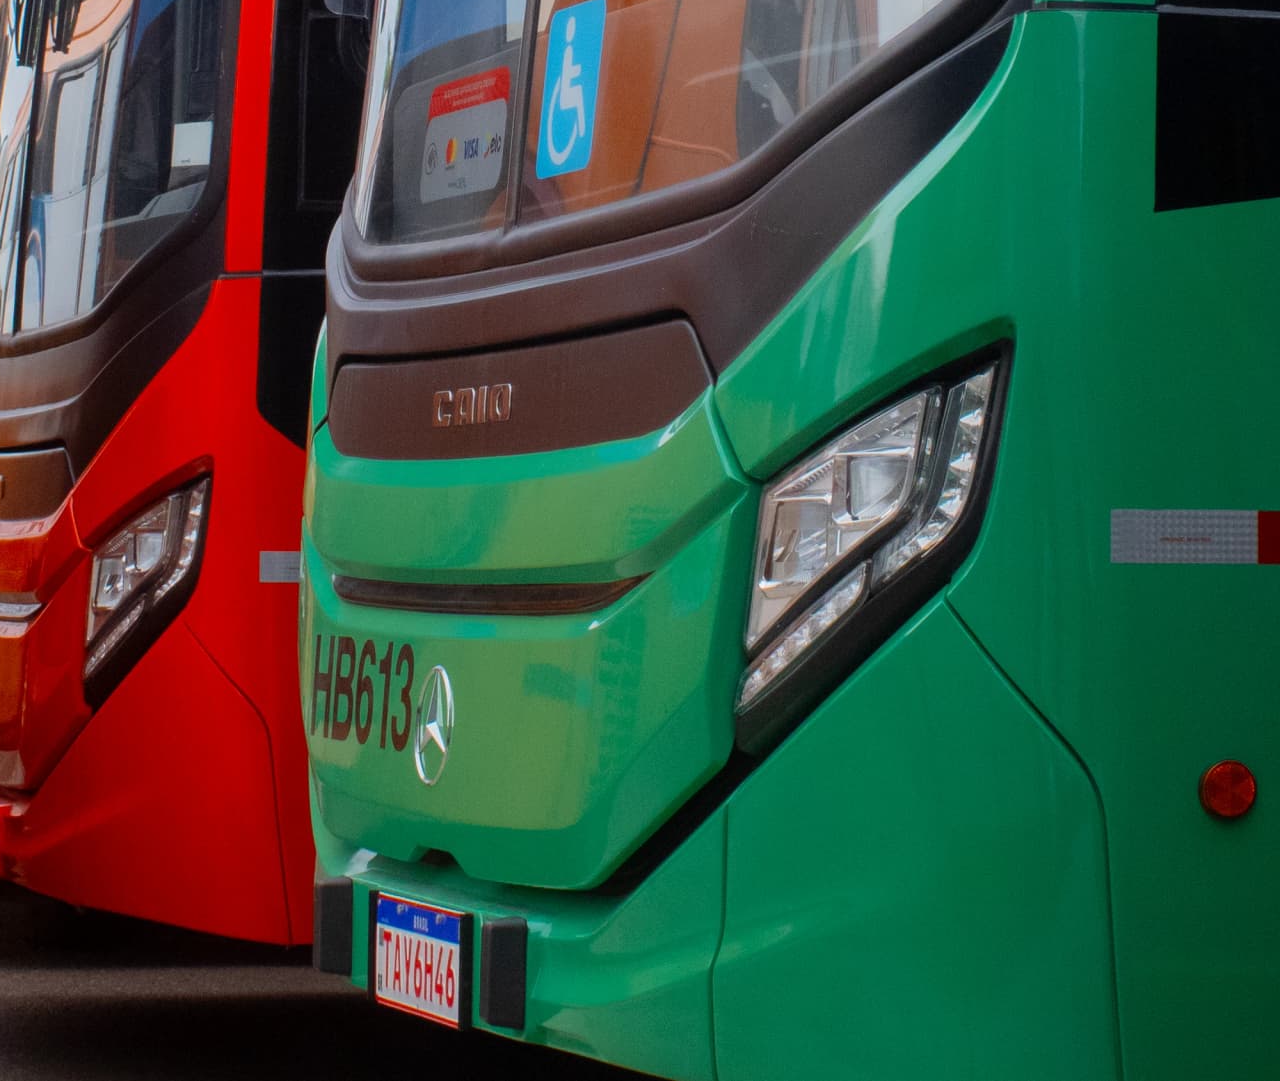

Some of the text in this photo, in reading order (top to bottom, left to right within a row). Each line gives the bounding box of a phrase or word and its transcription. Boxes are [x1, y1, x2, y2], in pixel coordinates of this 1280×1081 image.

[464, 138, 479, 160] VISA
[433, 383, 512, 428] CAIO
[310, 634, 415, 752] HB613
[383, 929, 456, 1009] TAY6H46
